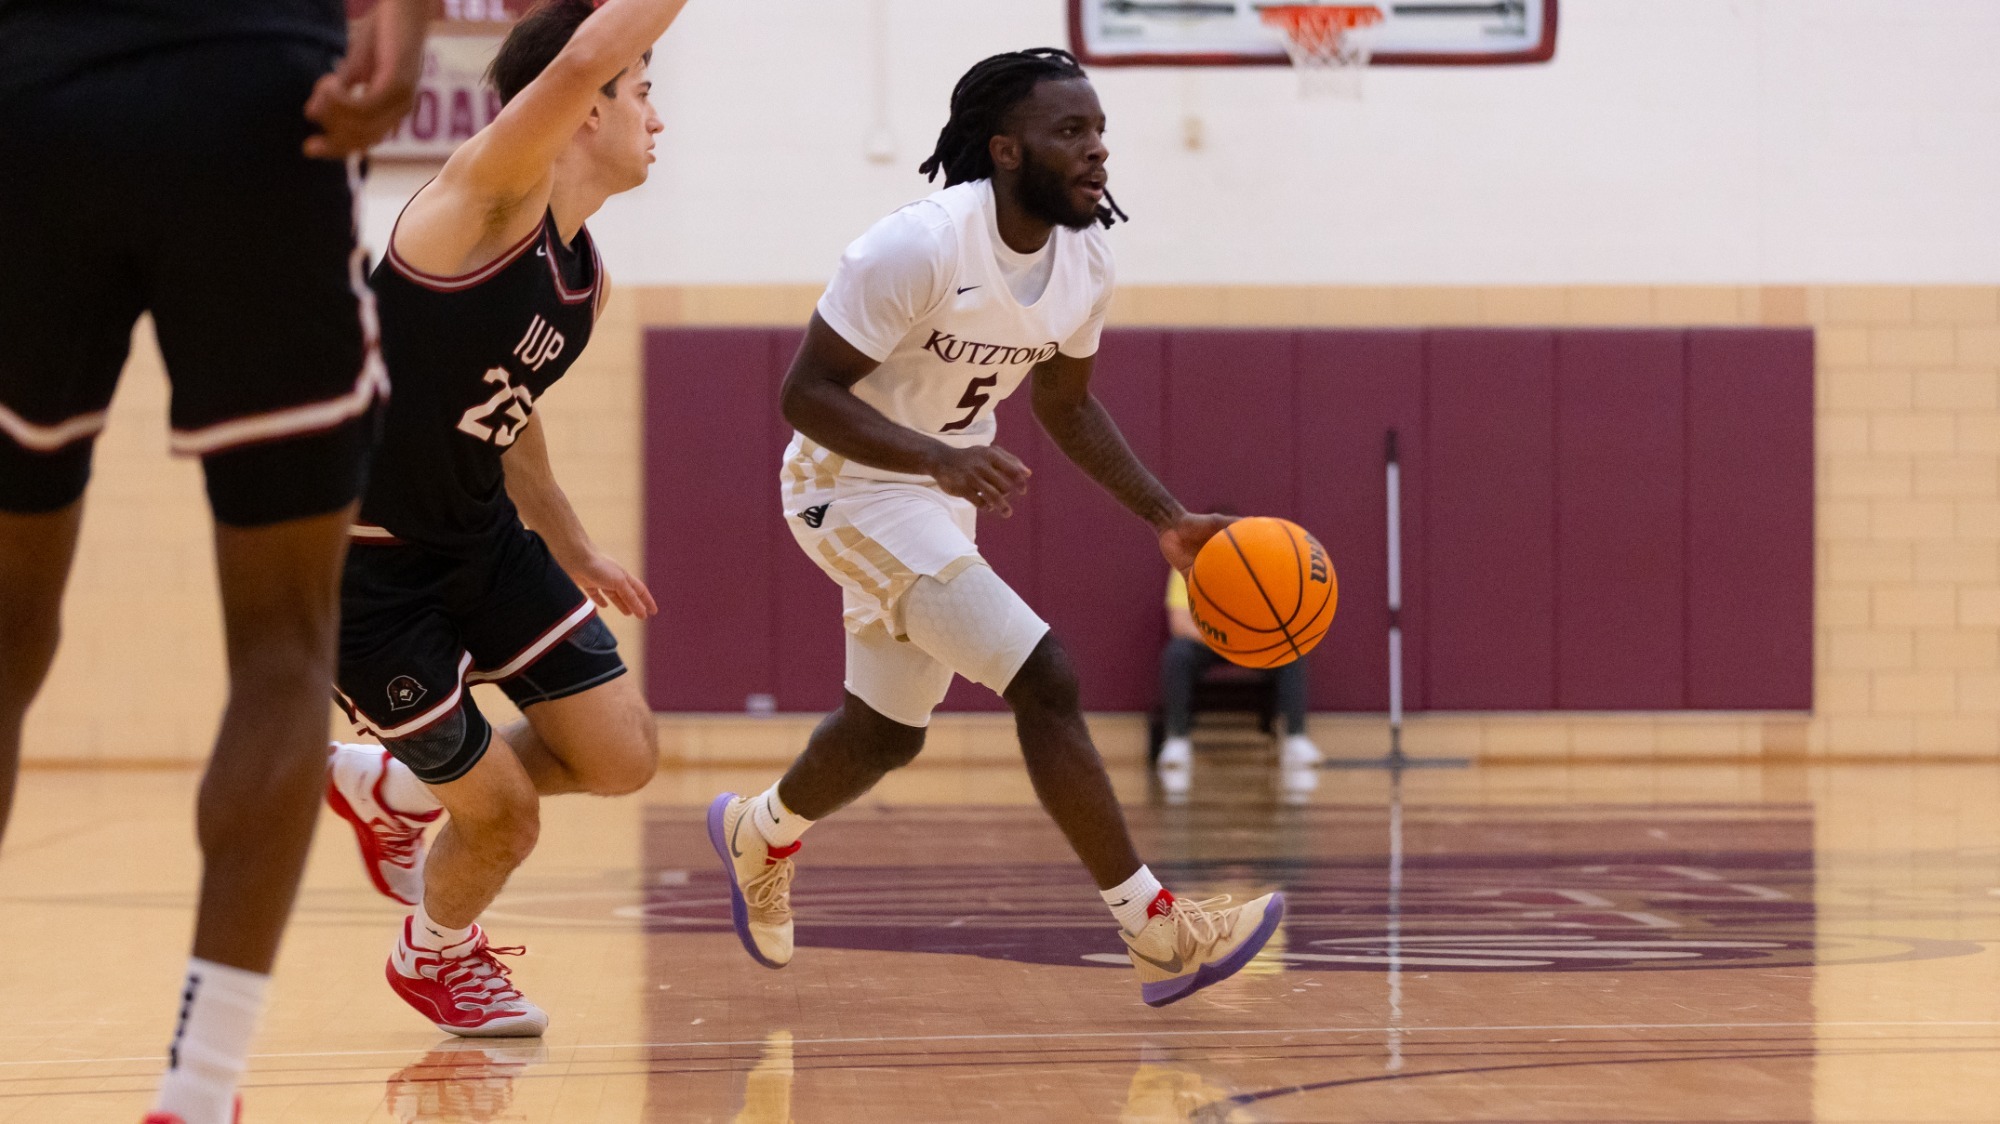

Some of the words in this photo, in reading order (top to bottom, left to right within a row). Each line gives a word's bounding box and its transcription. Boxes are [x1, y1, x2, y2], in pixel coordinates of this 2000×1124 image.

[513, 314, 564, 371] IUP
[457, 367, 533, 446] 25
[938, 372, 999, 432] 5
